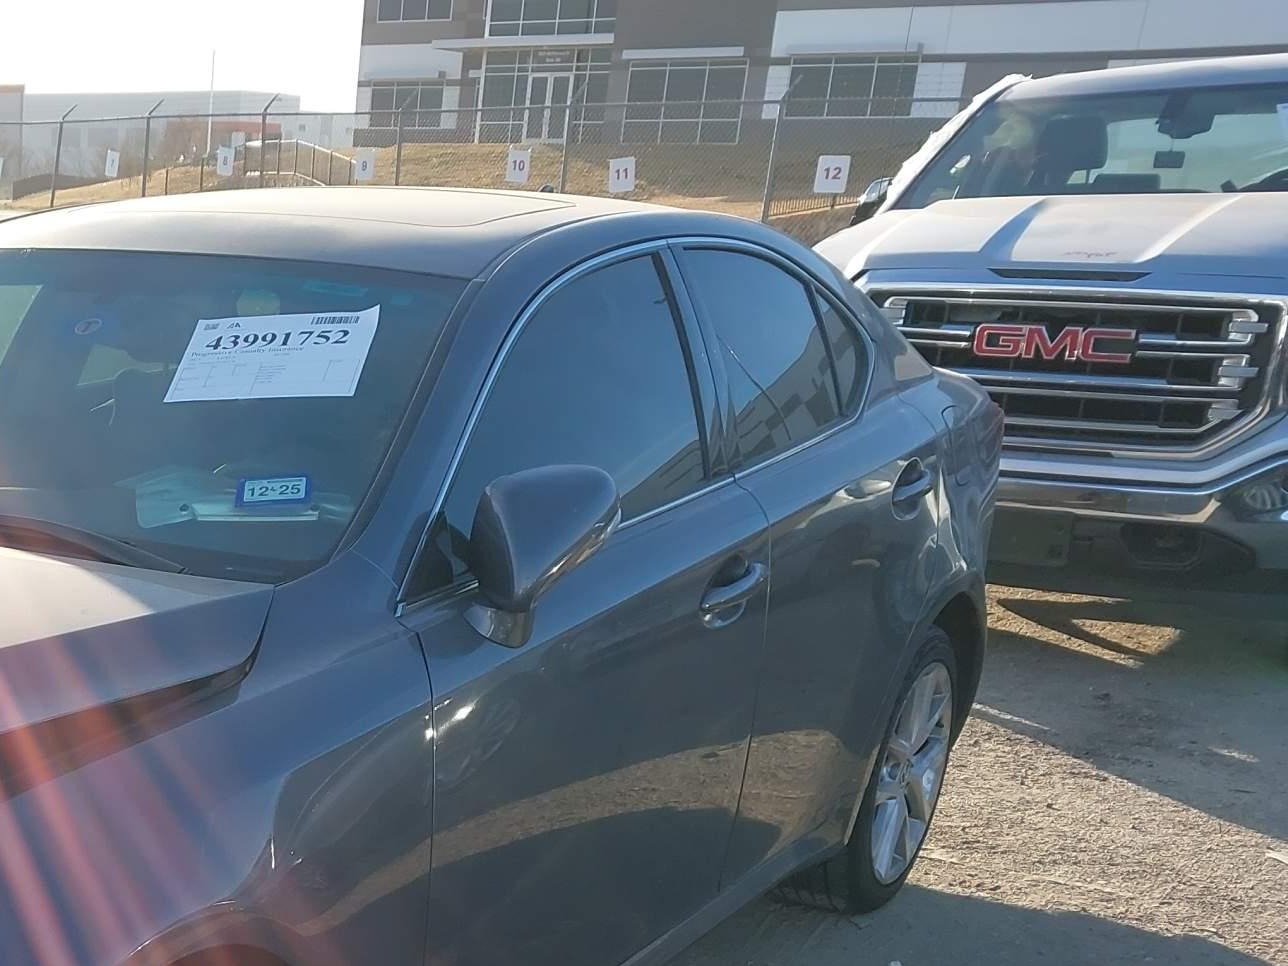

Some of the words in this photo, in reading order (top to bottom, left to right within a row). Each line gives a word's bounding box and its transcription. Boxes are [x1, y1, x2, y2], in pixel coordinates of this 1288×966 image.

[512, 159, 525, 171] 10
[615, 168, 629, 180] 11
[823, 167, 841, 179] 12
[206, 329, 350, 350] 43991752
[973, 323, 1136, 363] GMC
